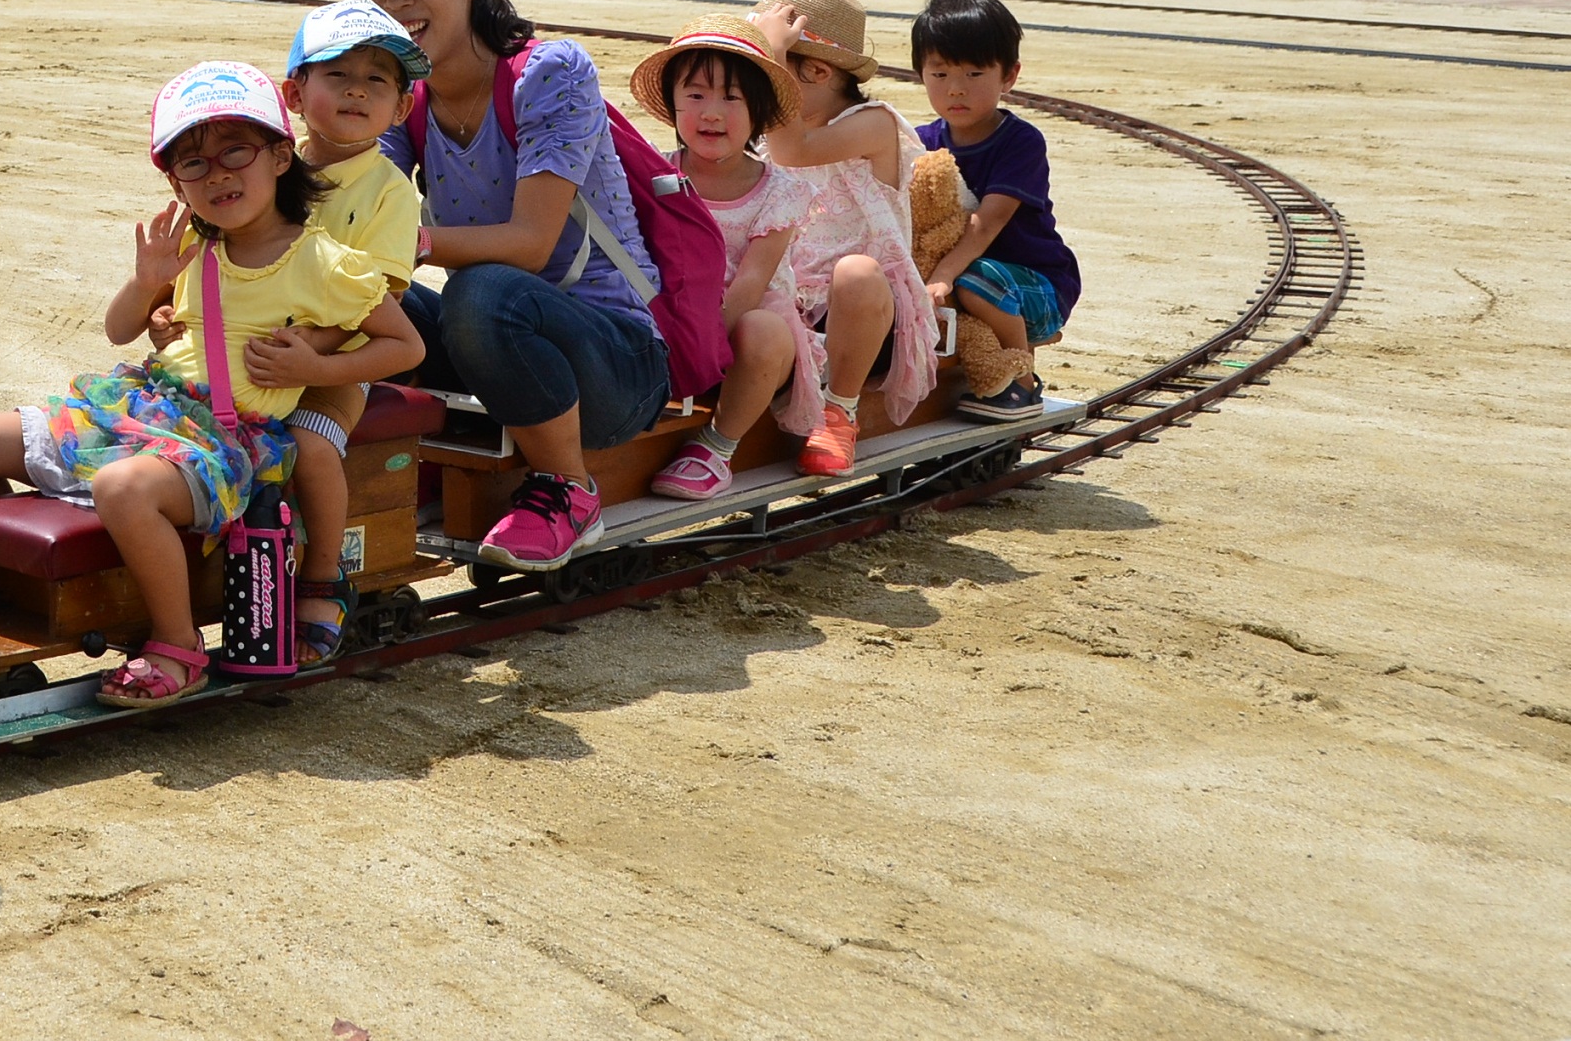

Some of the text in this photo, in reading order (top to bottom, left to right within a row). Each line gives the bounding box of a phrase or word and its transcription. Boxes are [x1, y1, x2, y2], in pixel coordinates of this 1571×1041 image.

[185, 97, 208, 108] WITH
[194, 89, 243, 99] CREATURE
[174, 102, 234, 123] Boundless
[251, 547, 260, 580] smart
[252, 581, 261, 604] and
